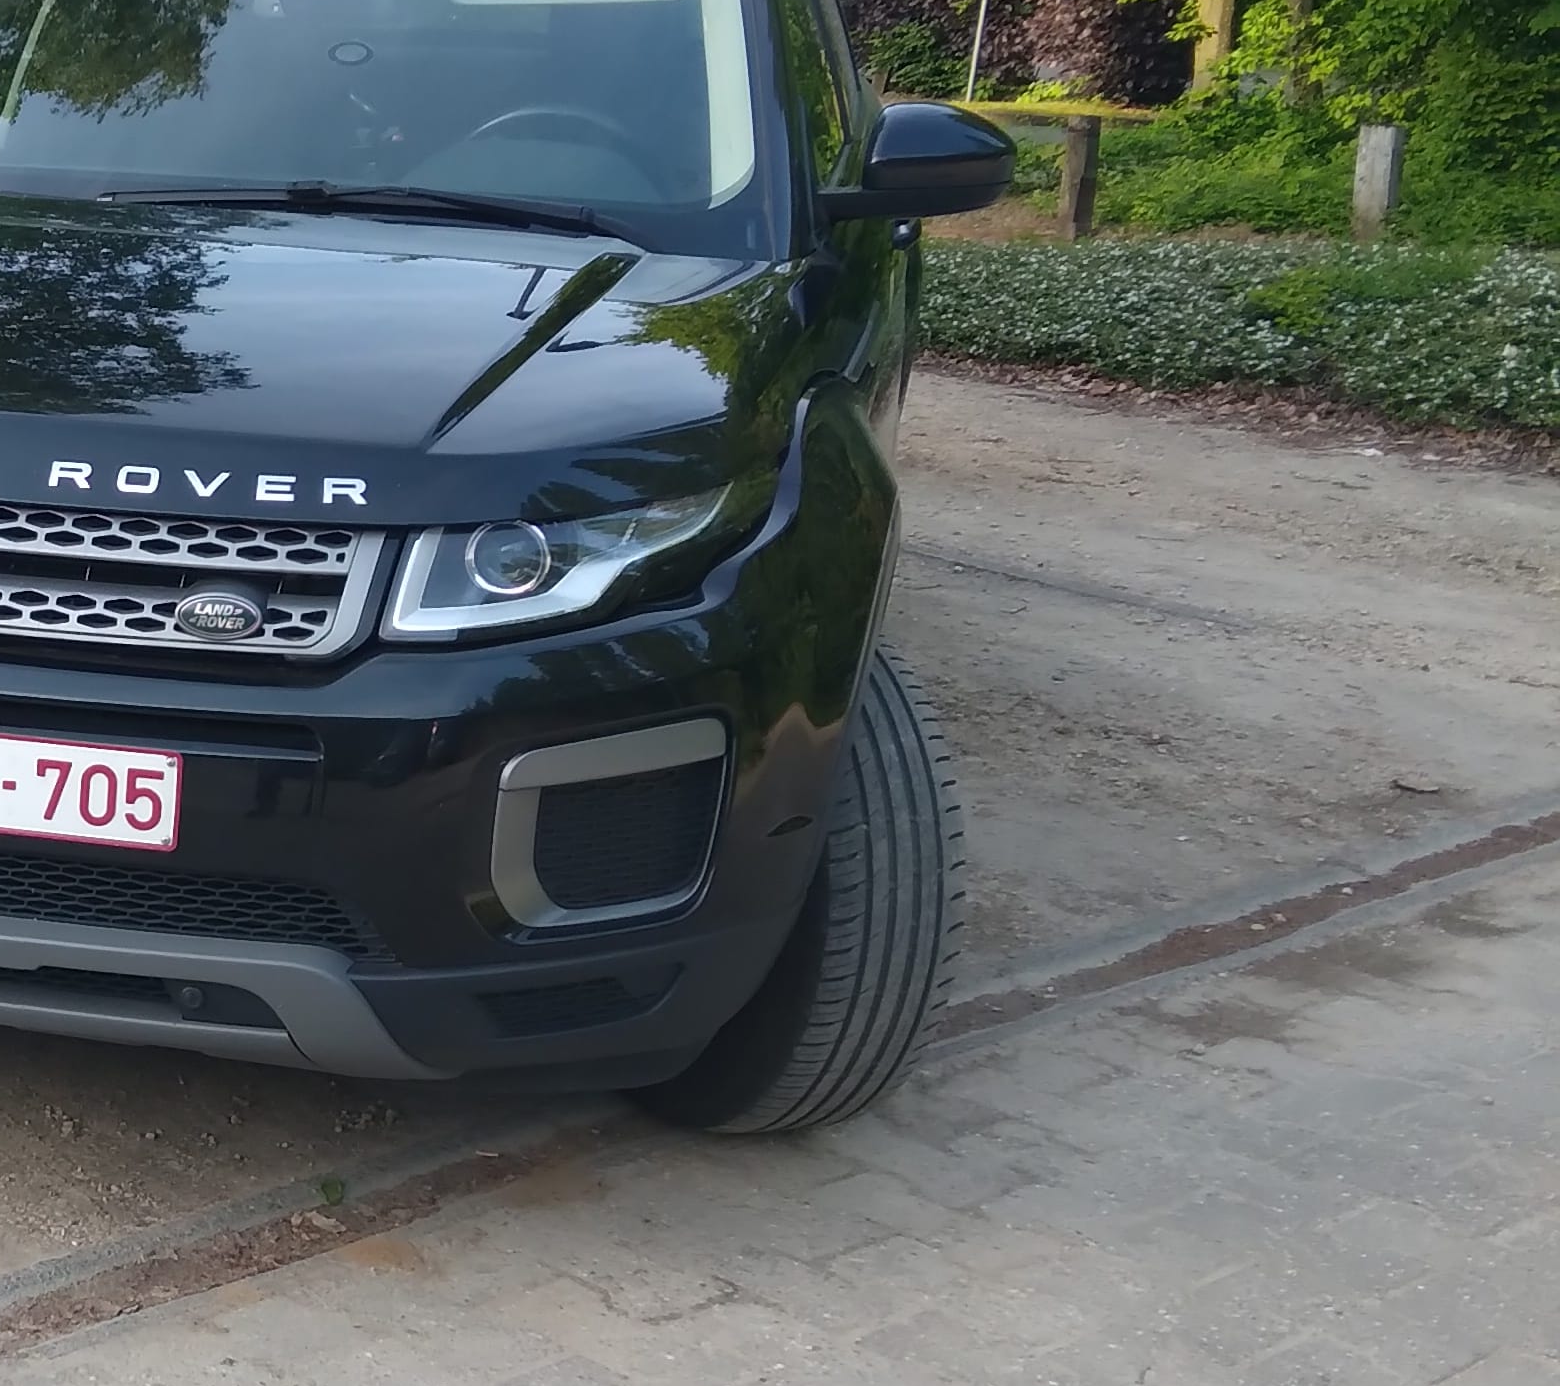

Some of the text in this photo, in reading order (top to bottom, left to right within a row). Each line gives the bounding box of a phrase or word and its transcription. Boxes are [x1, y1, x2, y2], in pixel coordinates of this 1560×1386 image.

[48, 460, 368, 505] ROVER
[193, 602, 234, 616] LAND
[195, 615, 245, 630] ROVER
